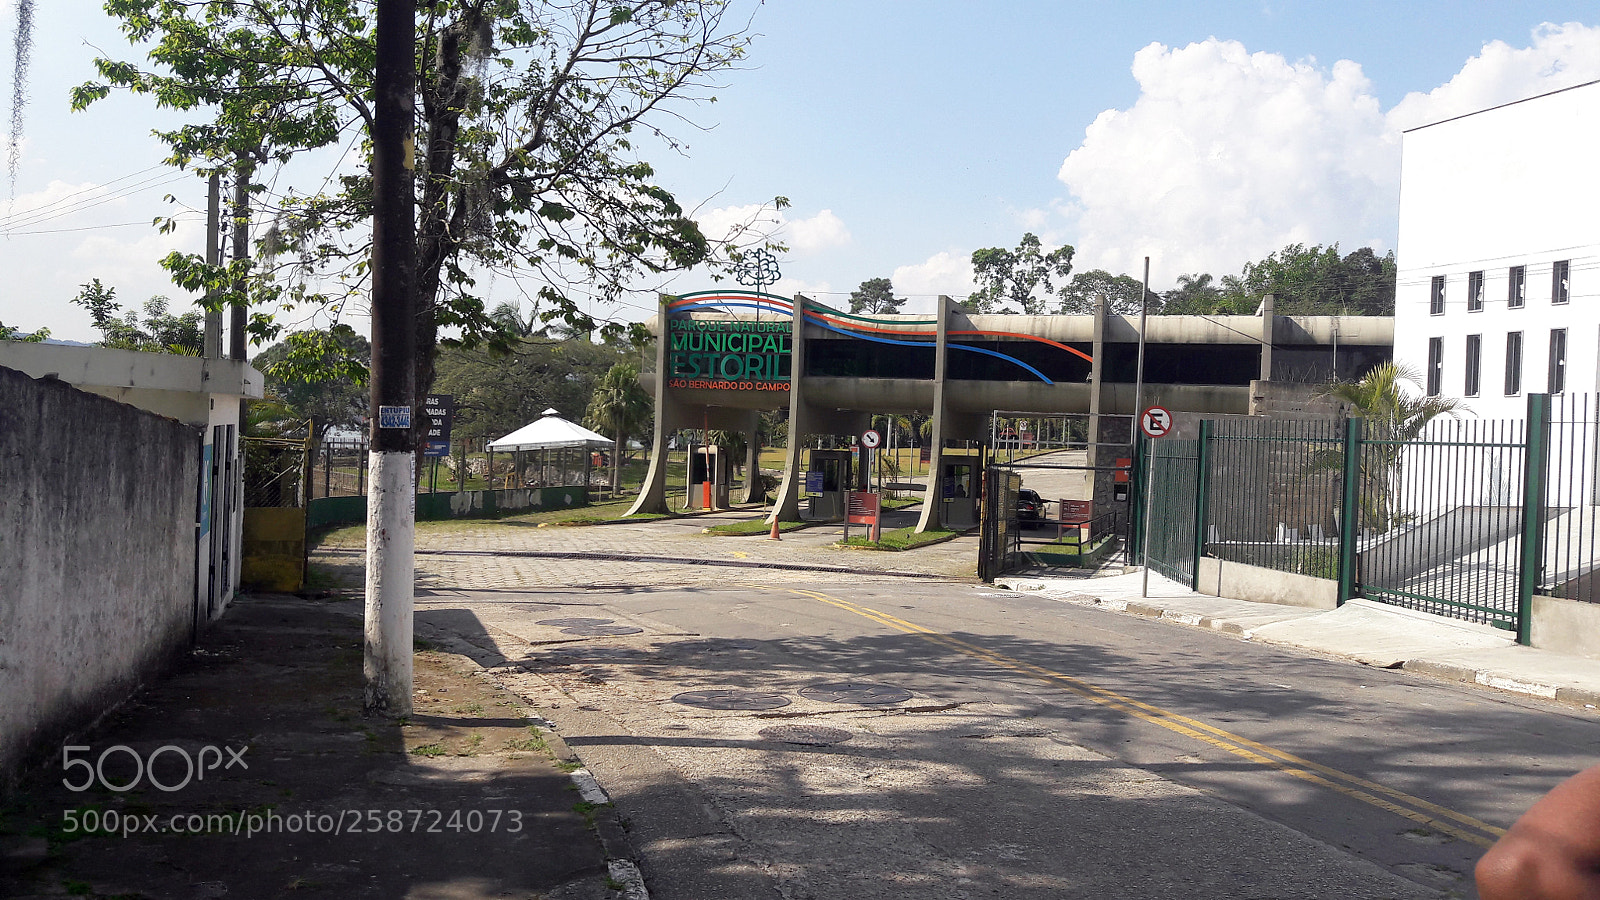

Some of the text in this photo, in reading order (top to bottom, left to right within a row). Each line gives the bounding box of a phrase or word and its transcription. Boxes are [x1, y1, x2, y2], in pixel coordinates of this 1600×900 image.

[670, 319, 792, 334] PARQUE NATURAL
[670, 332, 792, 353] MUNICIPAL
[669, 352, 791, 381] ESTORIL
[669, 378, 791, 392] SÃO BERNARDO DO CAMPO
[1150, 413, 1163, 430] E
